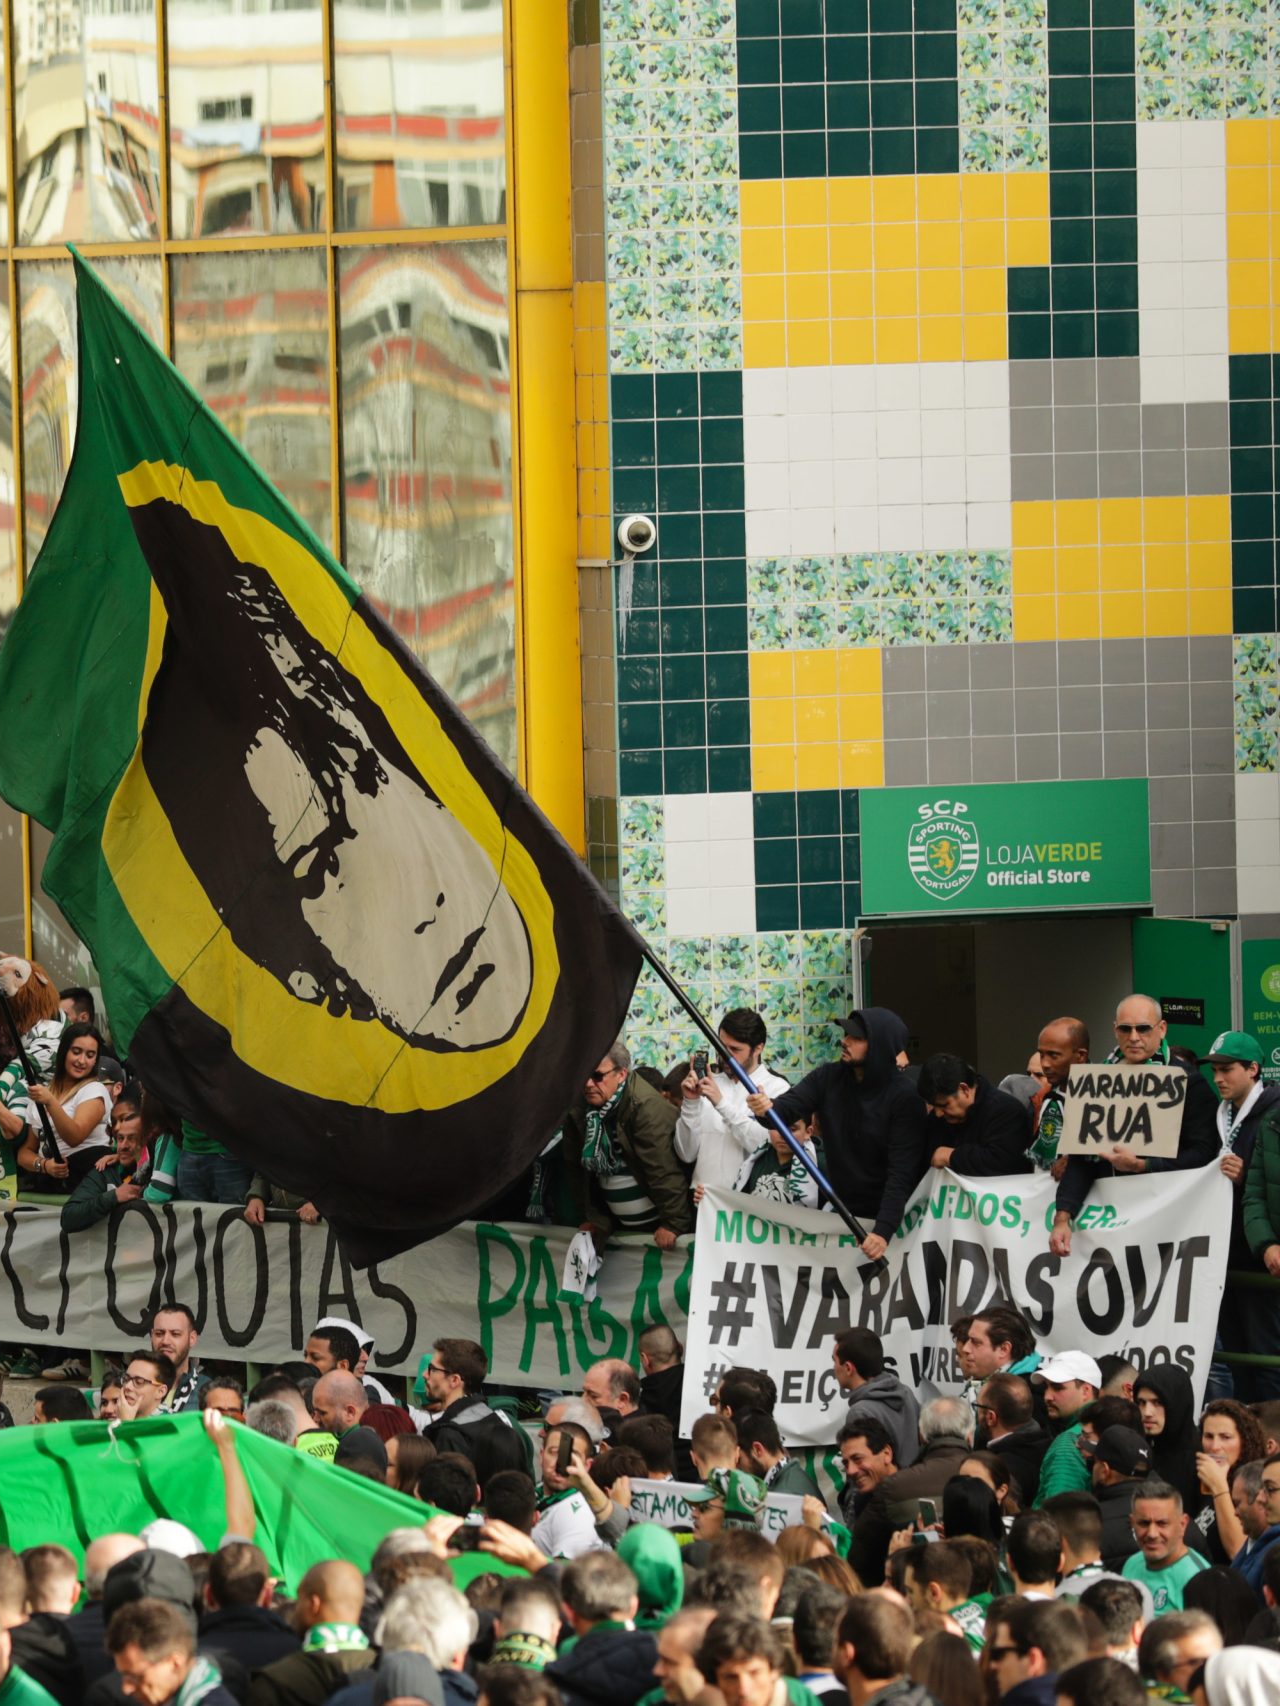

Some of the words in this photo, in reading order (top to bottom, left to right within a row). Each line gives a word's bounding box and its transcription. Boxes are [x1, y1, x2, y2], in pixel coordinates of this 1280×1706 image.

[918, 800, 968, 820] SCP
[915, 821, 972, 844] SPORTING
[920, 864, 971, 889] PORTUGAL
[987, 869, 1043, 886] Official
[1047, 869, 1091, 885] Store
[1067, 1072, 1188, 1108] VARANDAS
[1078, 1103, 1153, 1145] RUA
[105, 1200, 418, 1368] QUOTAS
